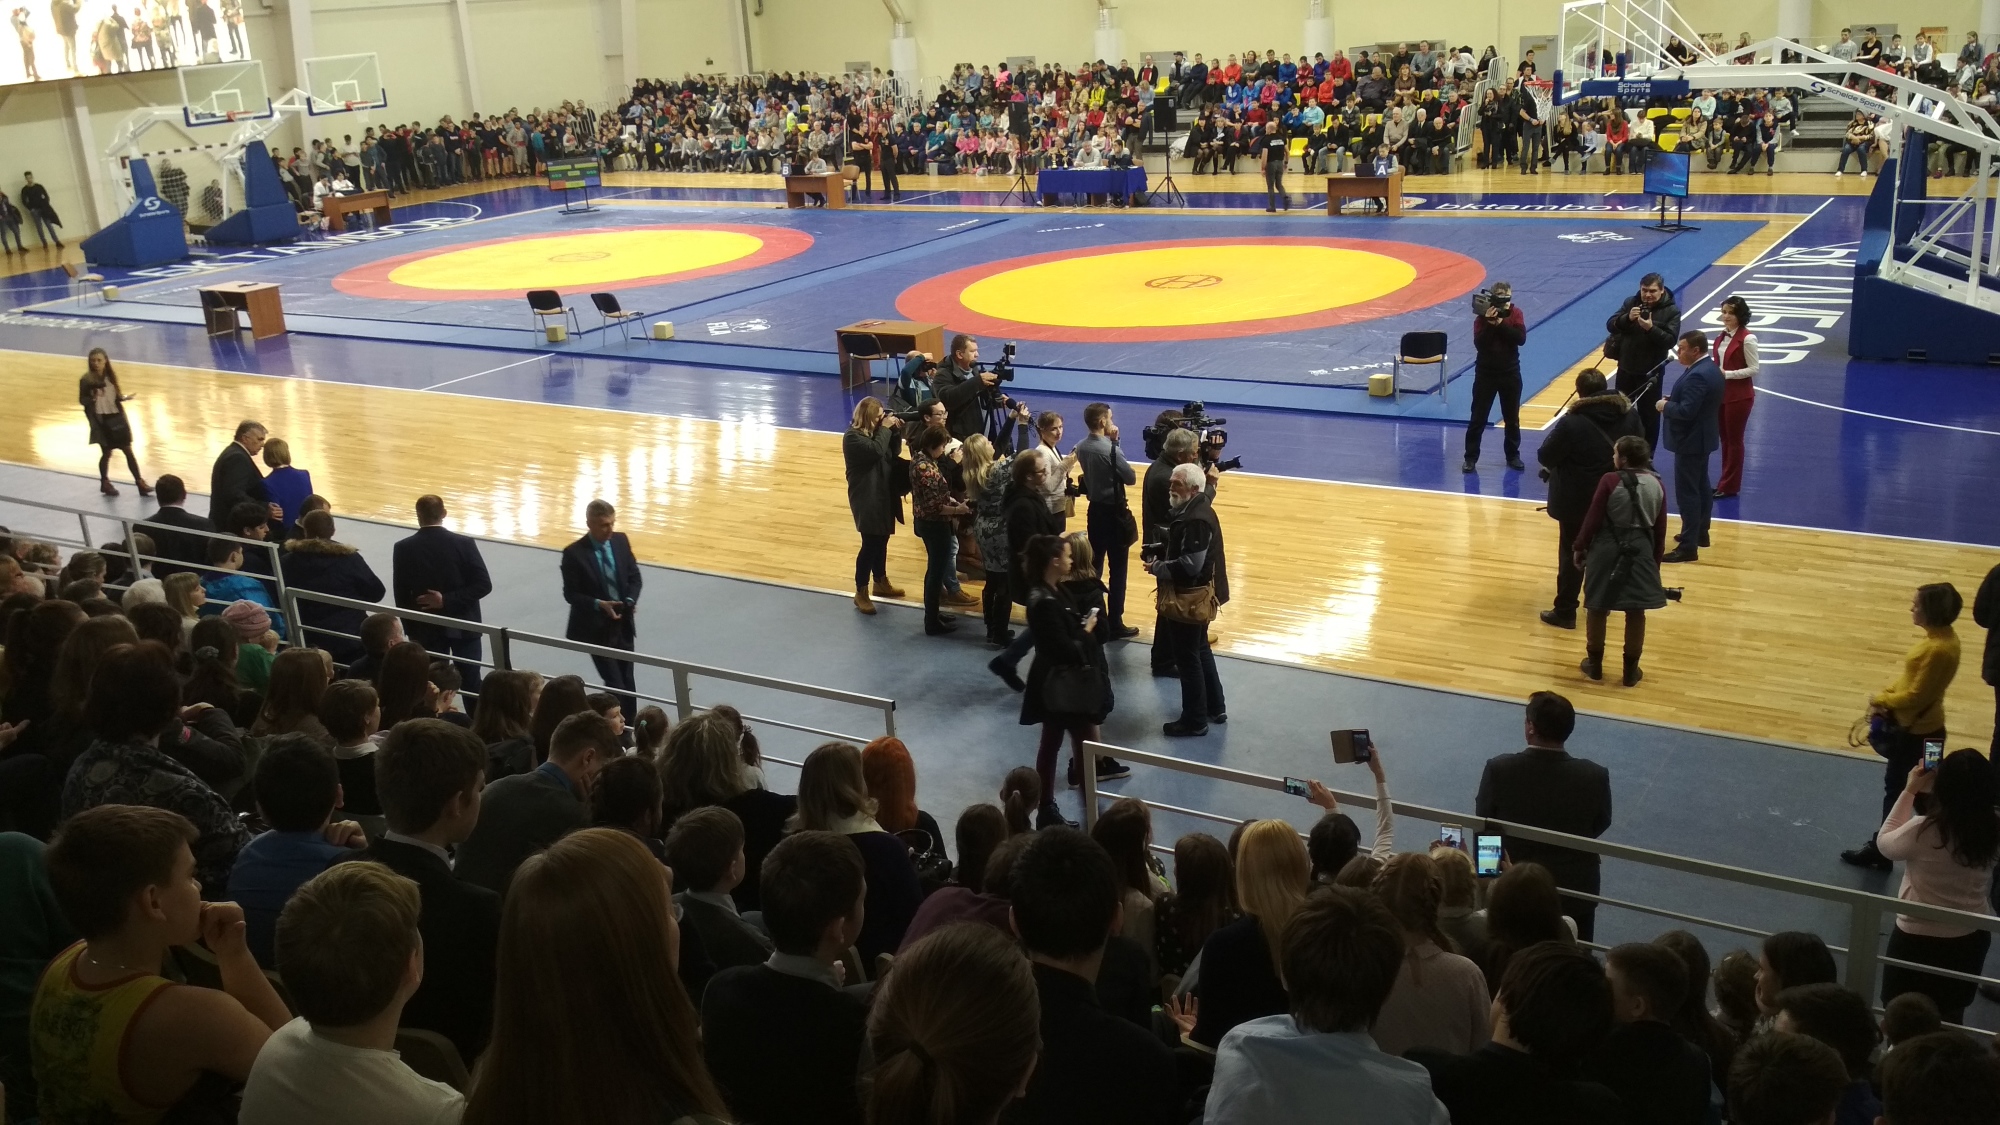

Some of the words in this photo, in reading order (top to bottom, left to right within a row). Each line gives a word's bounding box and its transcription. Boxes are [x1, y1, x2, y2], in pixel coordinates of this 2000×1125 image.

[1826, 86, 1859, 102] Schelde
[1859, 97, 1886, 111] Sports
[782, 166, 789, 175] B
[1376, 164, 1387, 175] A
